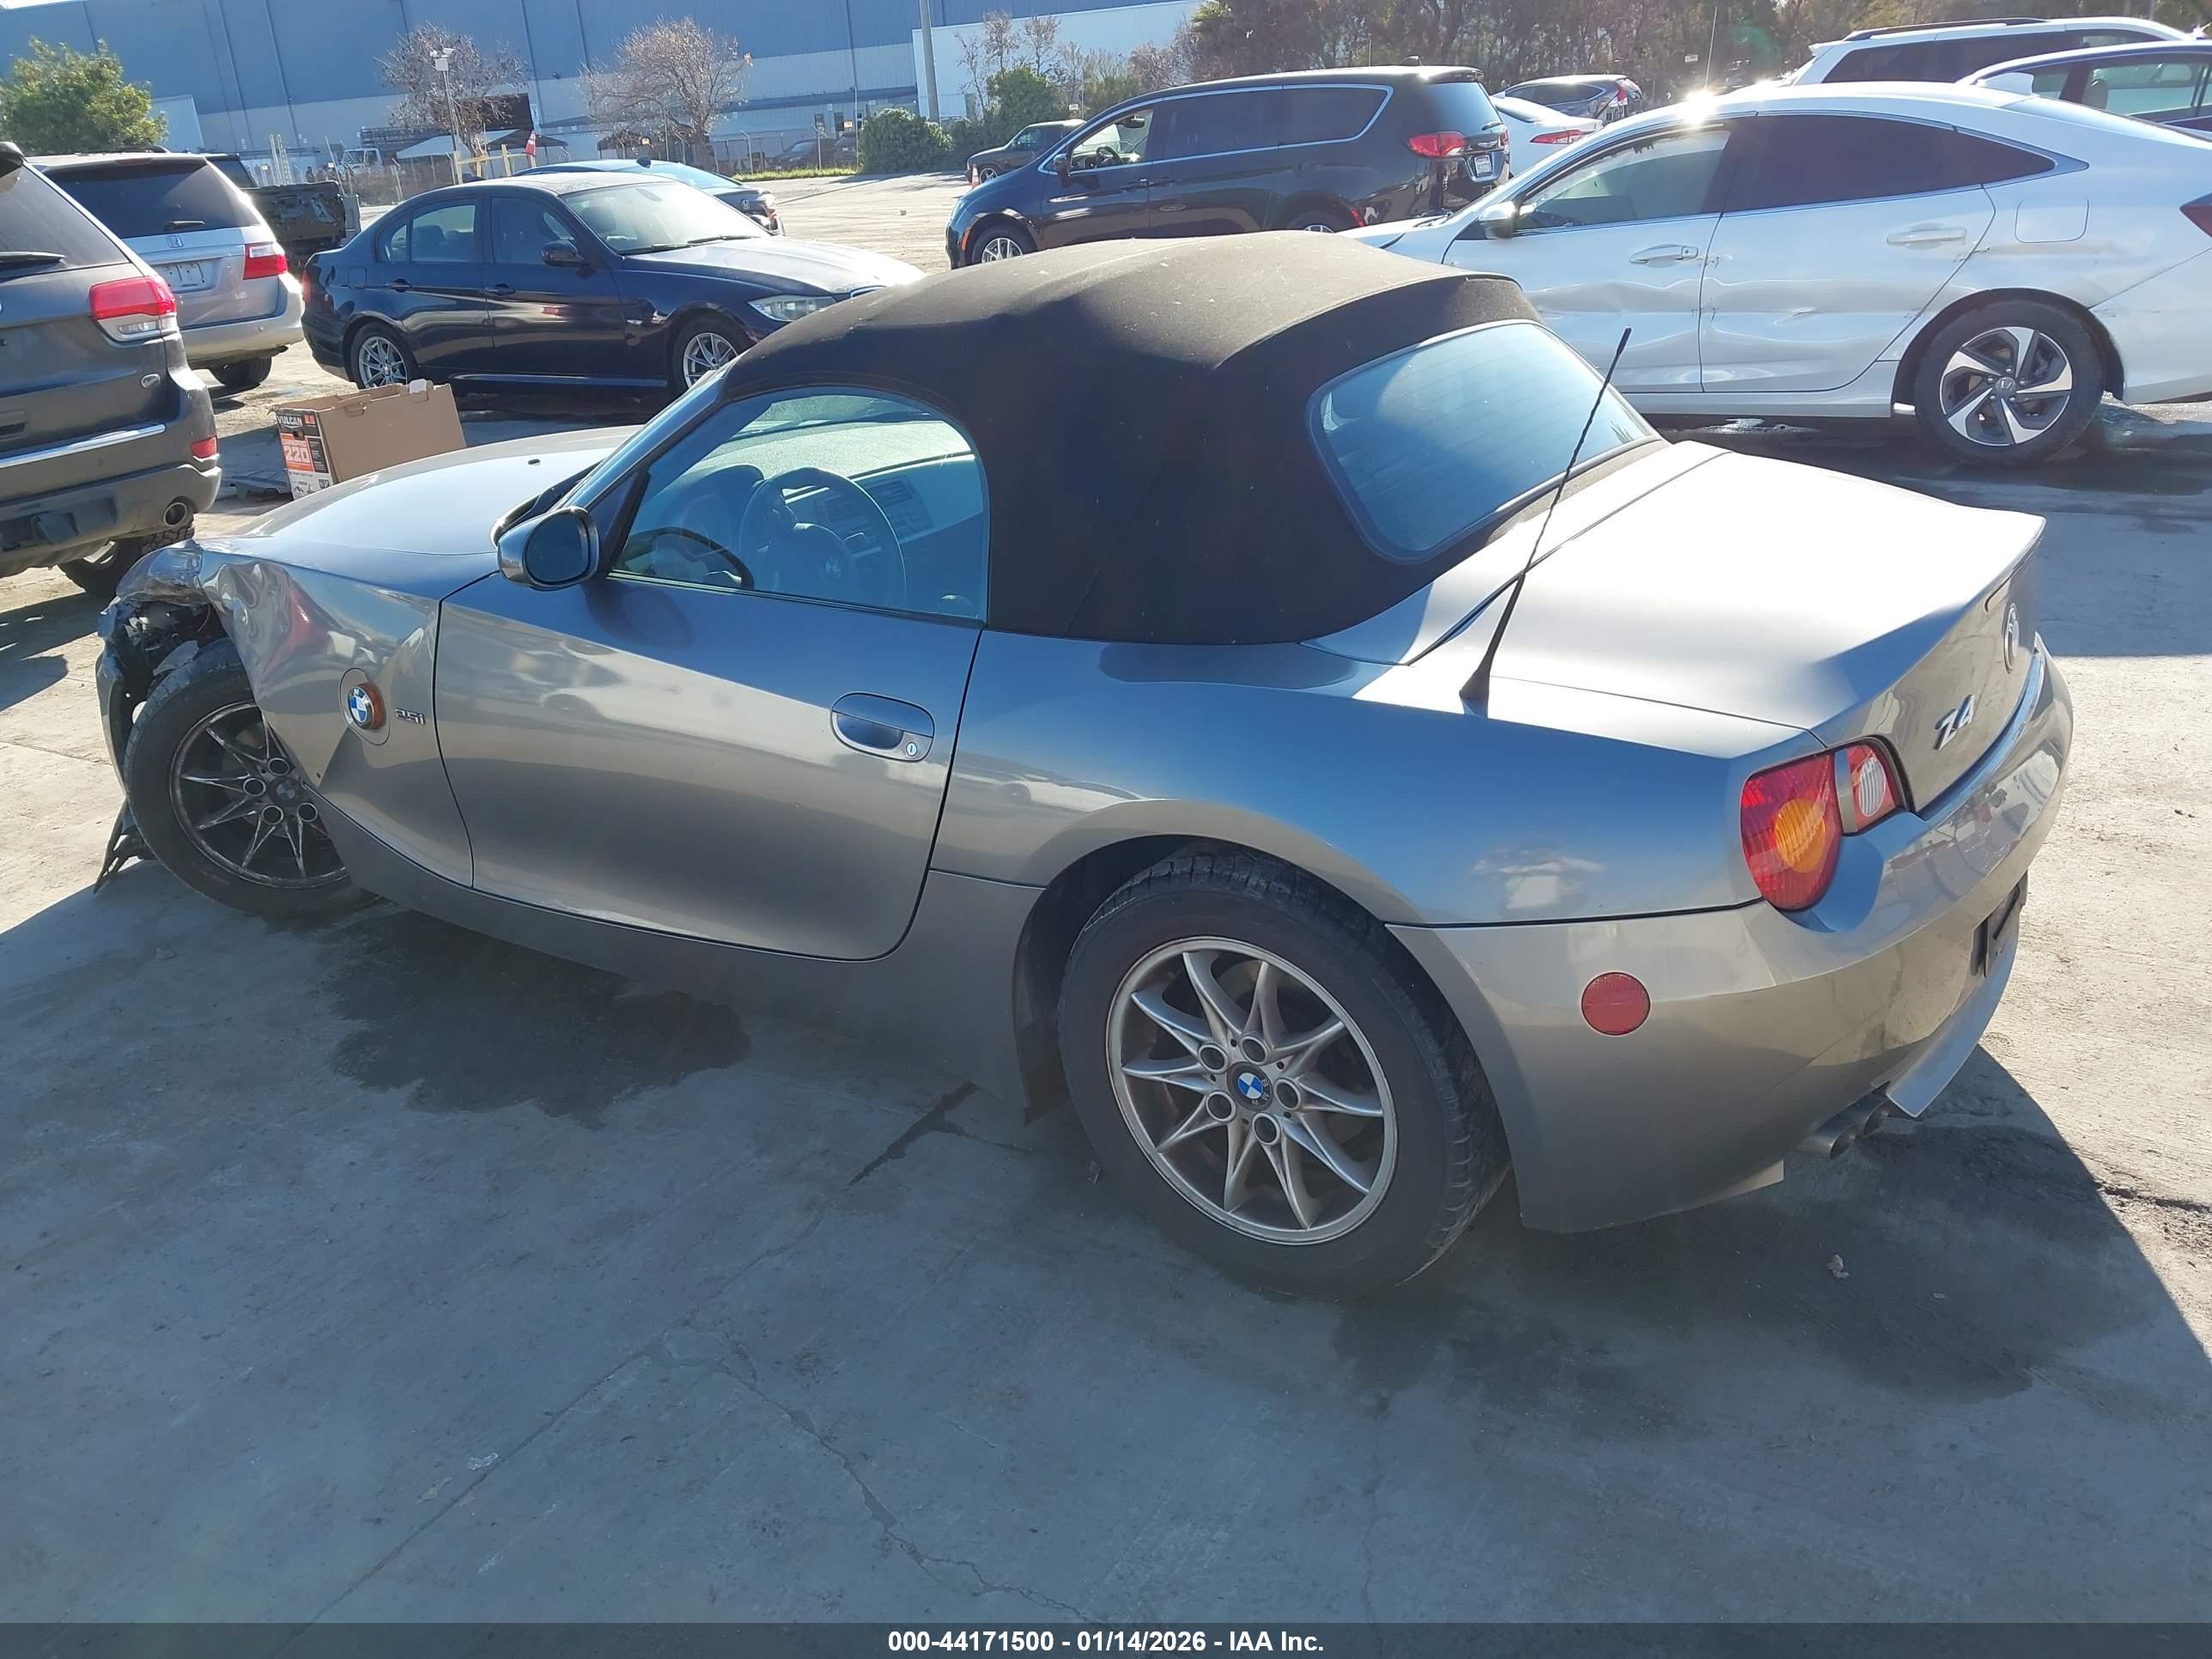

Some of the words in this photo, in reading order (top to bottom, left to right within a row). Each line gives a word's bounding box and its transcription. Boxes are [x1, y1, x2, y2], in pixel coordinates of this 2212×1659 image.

[276, 415, 303, 426] VULCAN
[283, 446, 310, 463] 220
[1934, 694, 1975, 750] Z4
